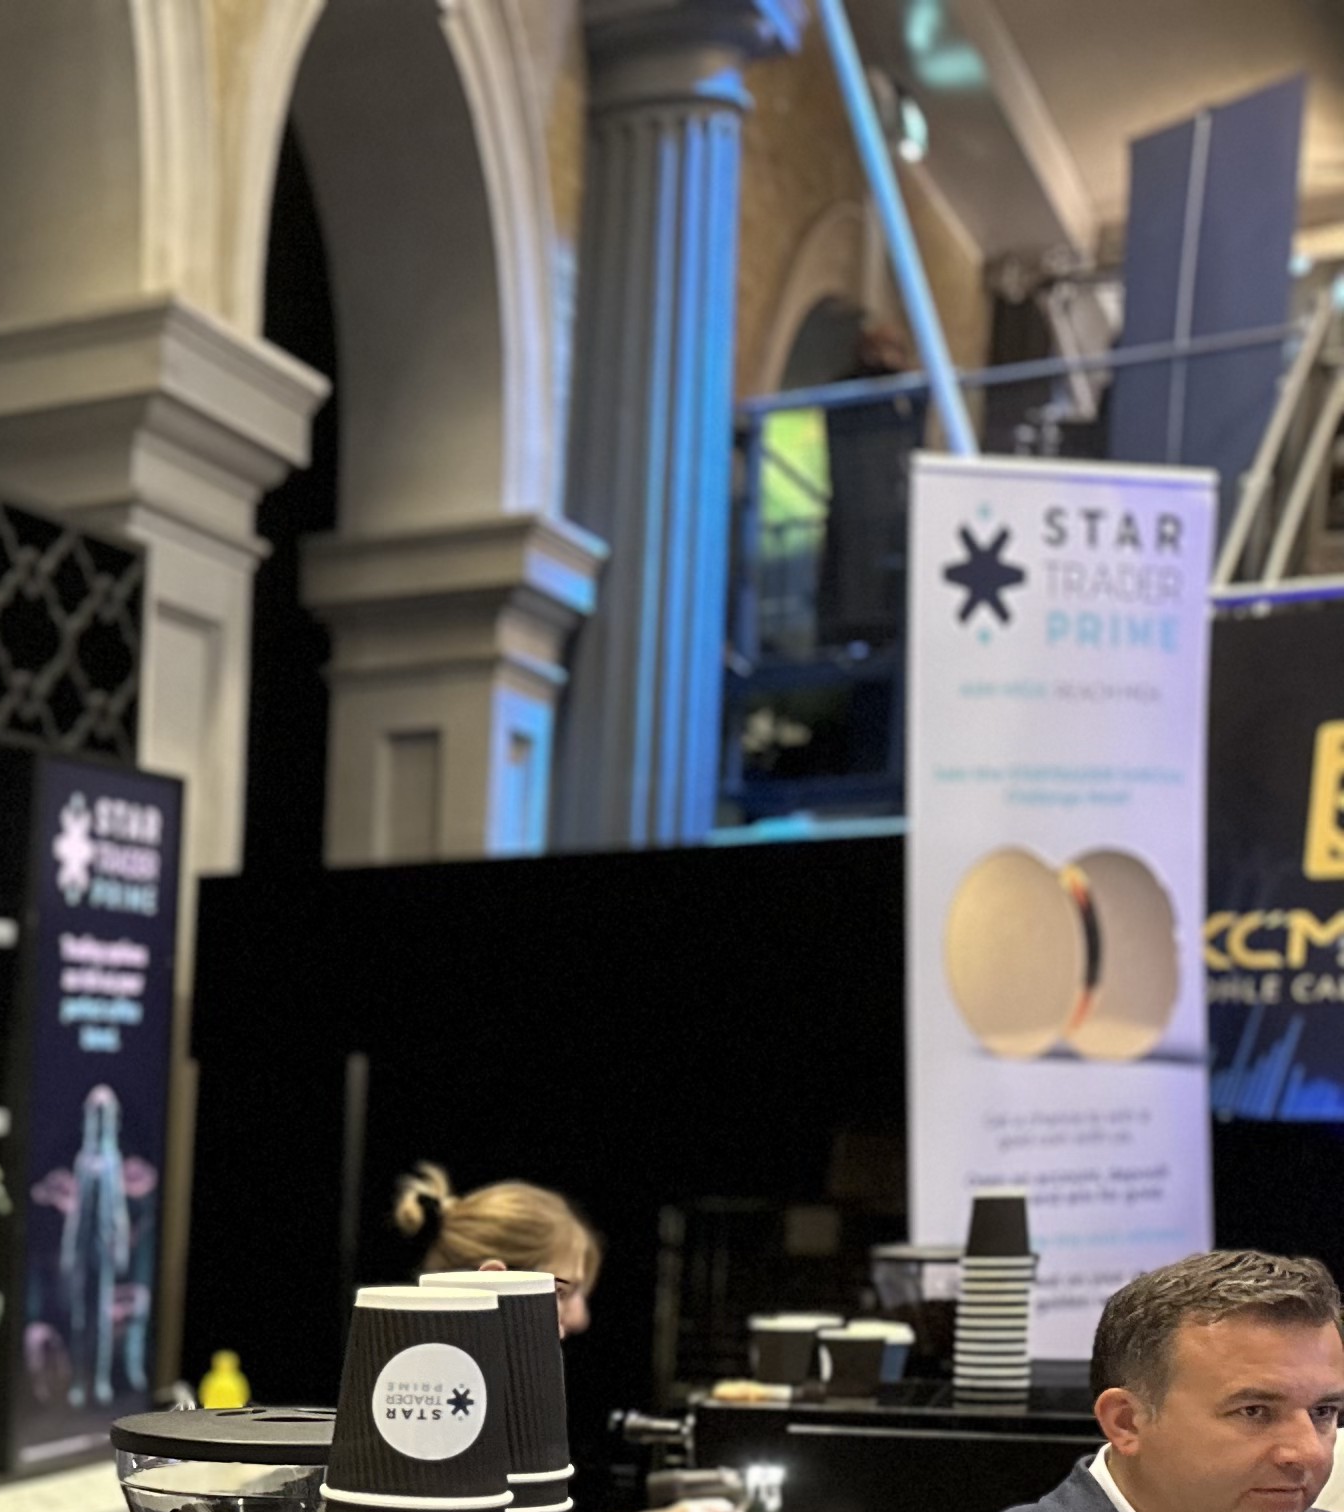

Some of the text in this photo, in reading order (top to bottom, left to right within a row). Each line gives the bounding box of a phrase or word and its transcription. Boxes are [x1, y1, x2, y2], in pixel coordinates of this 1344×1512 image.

[1042, 507, 1183, 553] STAR
[1043, 559, 1183, 603] TRADER
[1045, 610, 1181, 656] PRIME
[385, 1393, 443, 1406] TRADER
[385, 1407, 442, 1421] STAR
